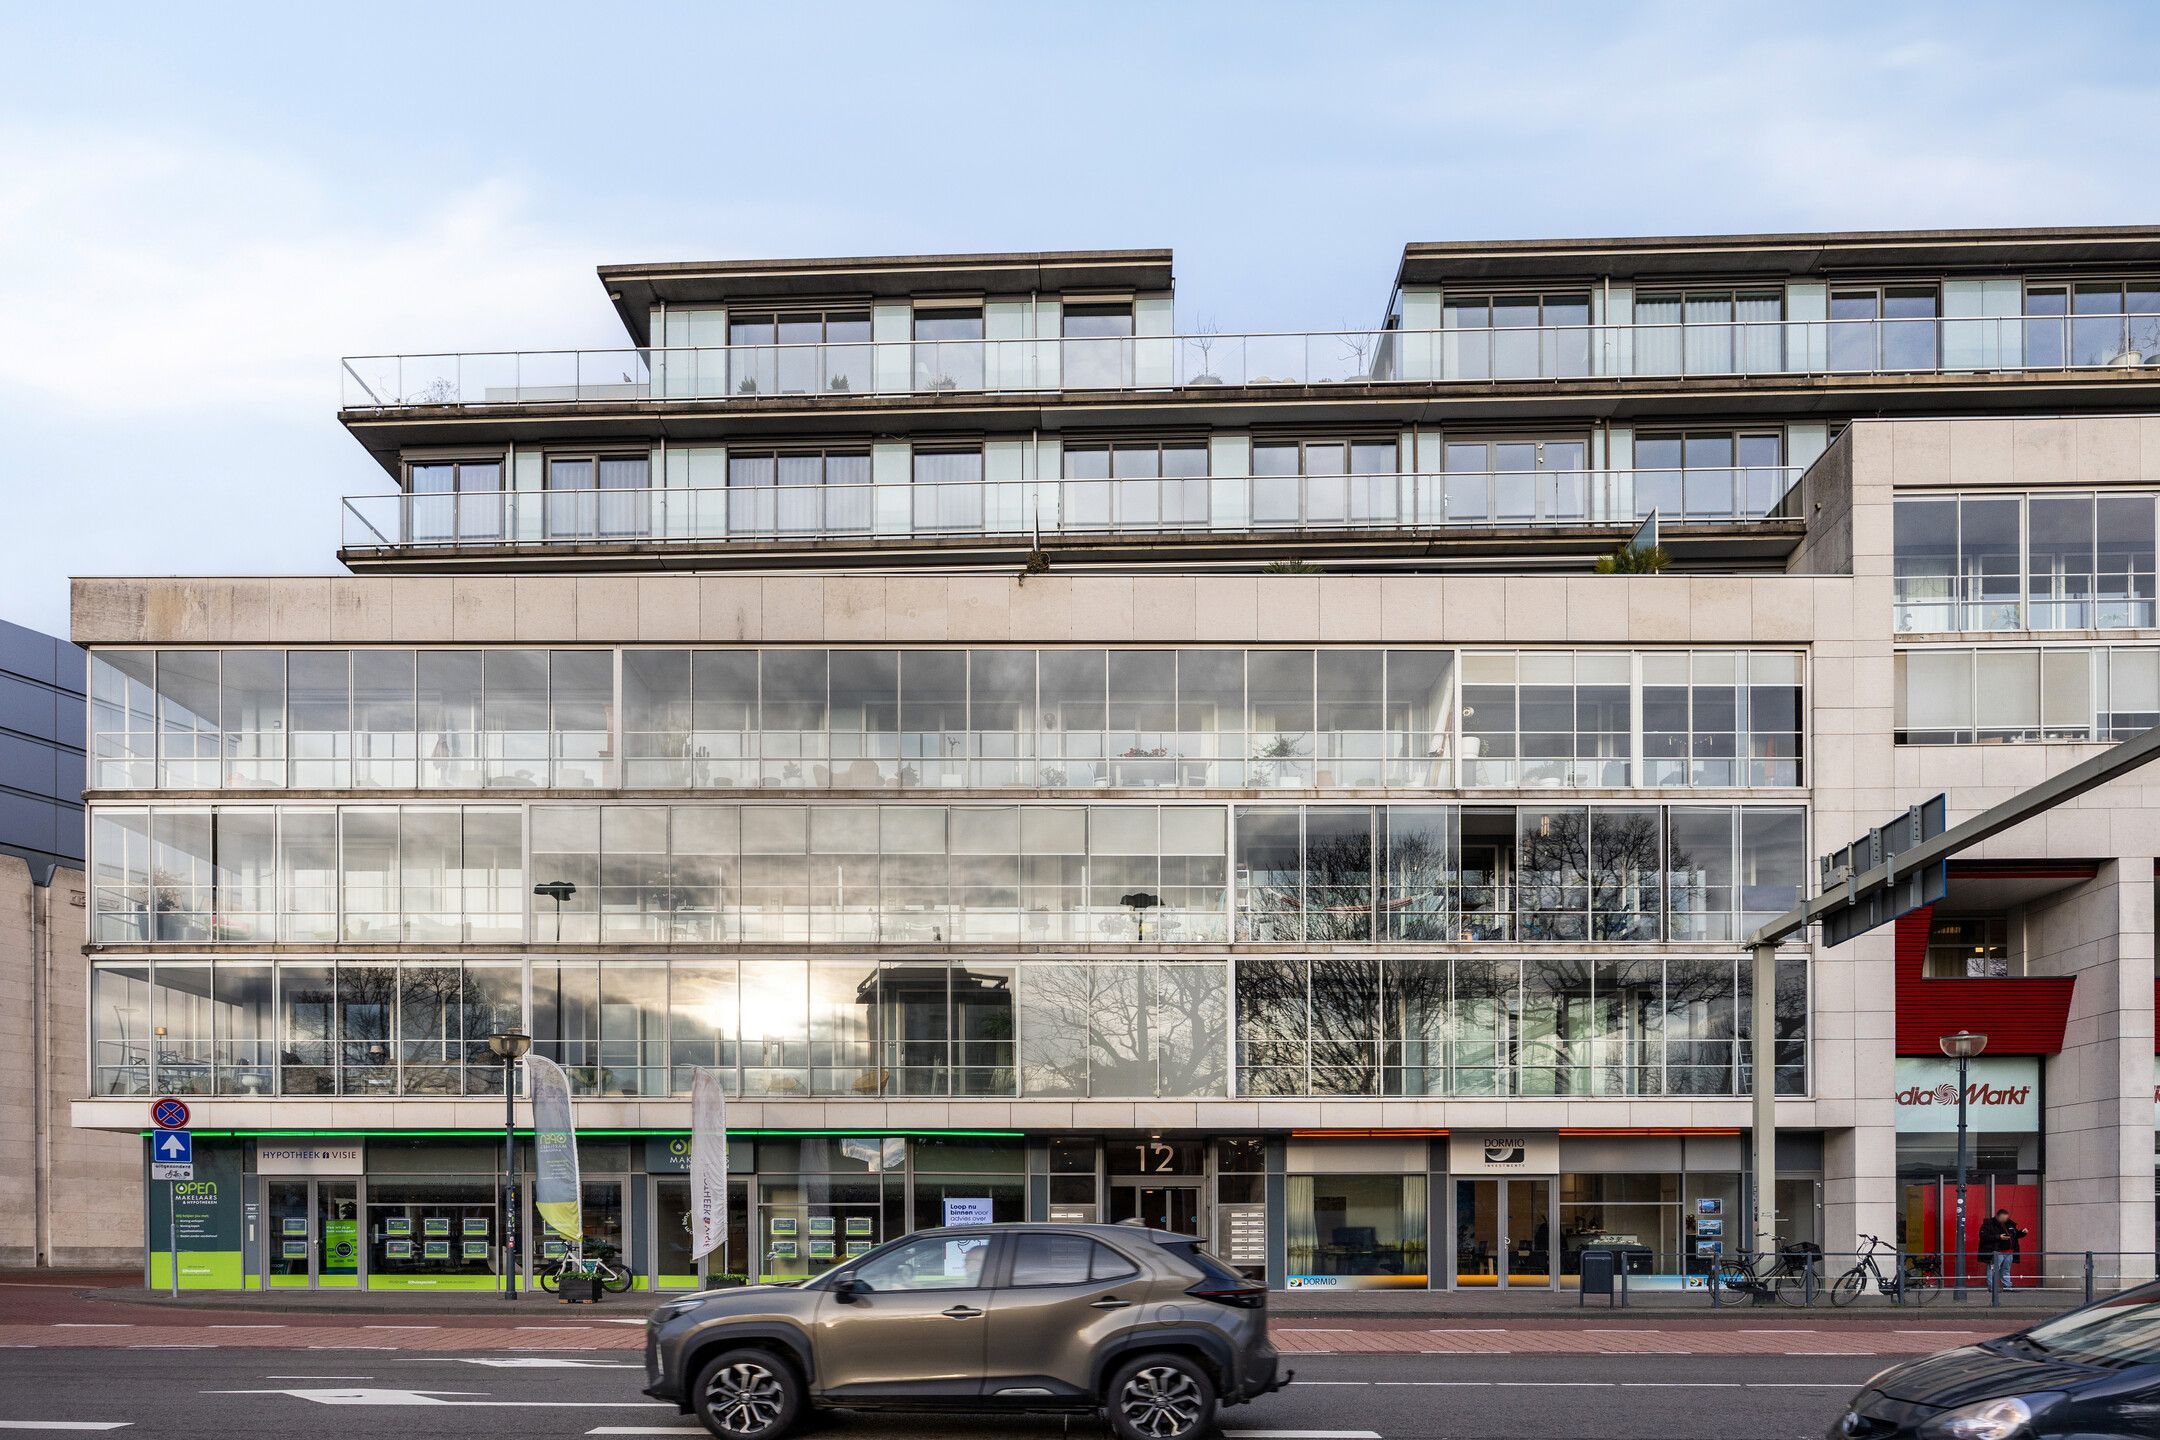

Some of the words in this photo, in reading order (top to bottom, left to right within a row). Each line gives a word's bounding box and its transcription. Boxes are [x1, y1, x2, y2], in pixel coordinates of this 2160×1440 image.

[1894, 1086, 1934, 1105] dia
[1484, 1138, 1525, 1148] DORMIO
[263, 1151, 320, 1159] HYPOTHEEK
[331, 1151, 356, 1159] VISIE
[1135, 1145, 1174, 1172] 12
[175, 1181, 218, 1195] OPEN
[1303, 1277, 1337, 1286] DORMIO
